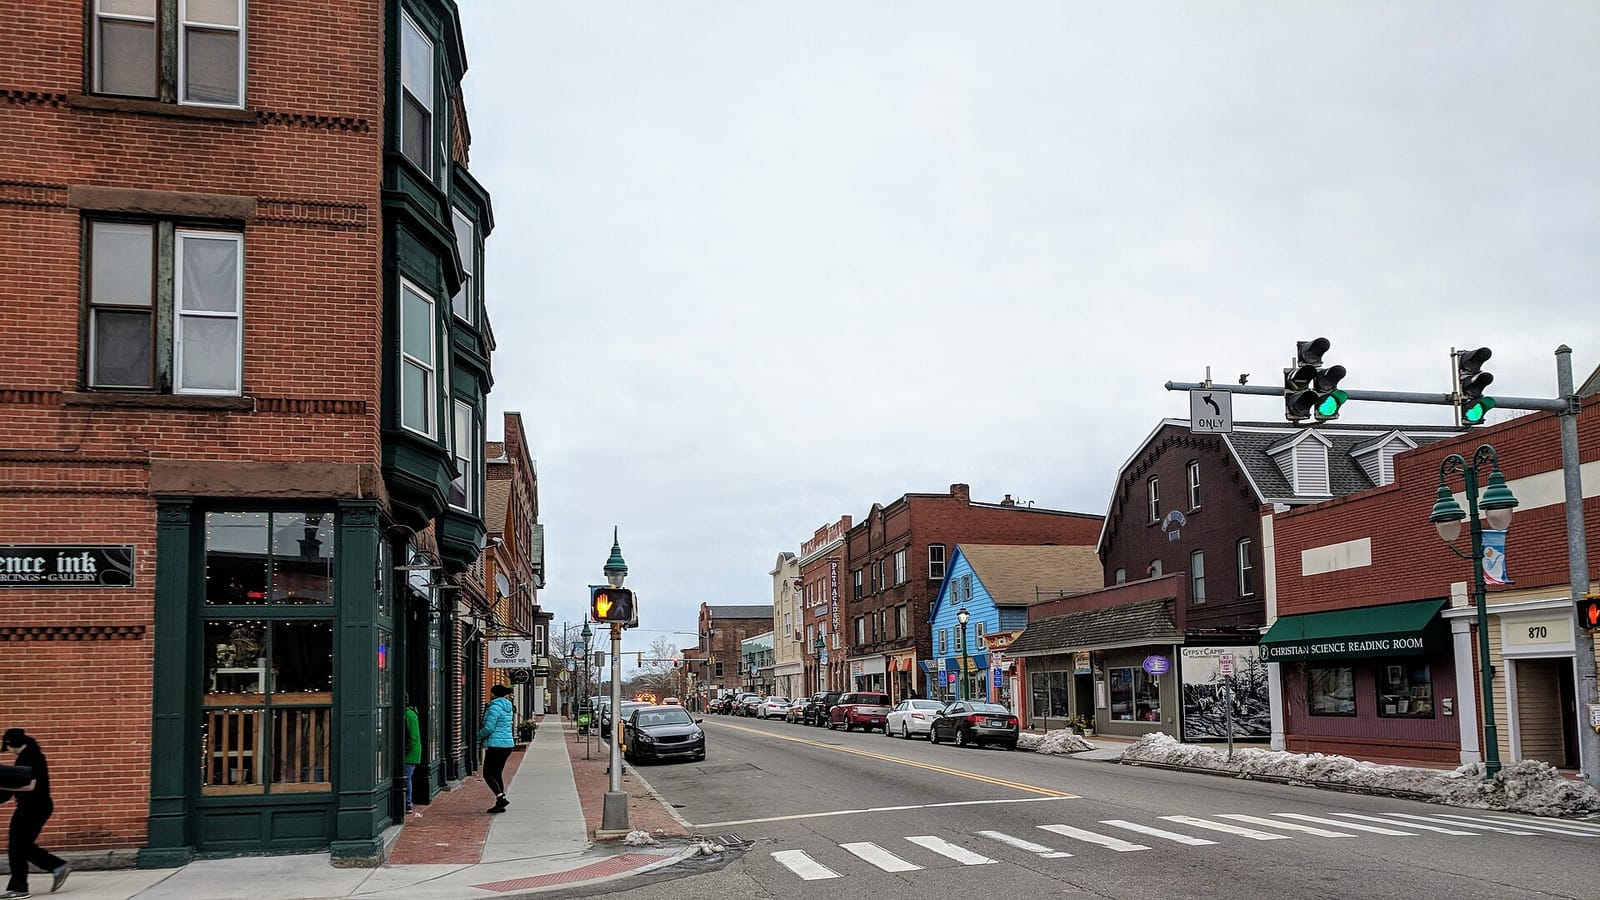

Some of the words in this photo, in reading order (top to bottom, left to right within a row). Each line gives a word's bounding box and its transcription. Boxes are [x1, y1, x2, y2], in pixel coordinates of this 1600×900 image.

[1199, 419, 1225, 428] ONLY
[56, 552, 97, 573] ink
[0, 573, 41, 582] RCINGS
[1528, 626, 1547, 639] 870
[1270, 645, 1310, 657] CHRISTIAN
[1311, 642, 1346, 654] SCIENCE
[1348, 639, 1390, 652] READING
[1393, 637, 1424, 649] ROOM
